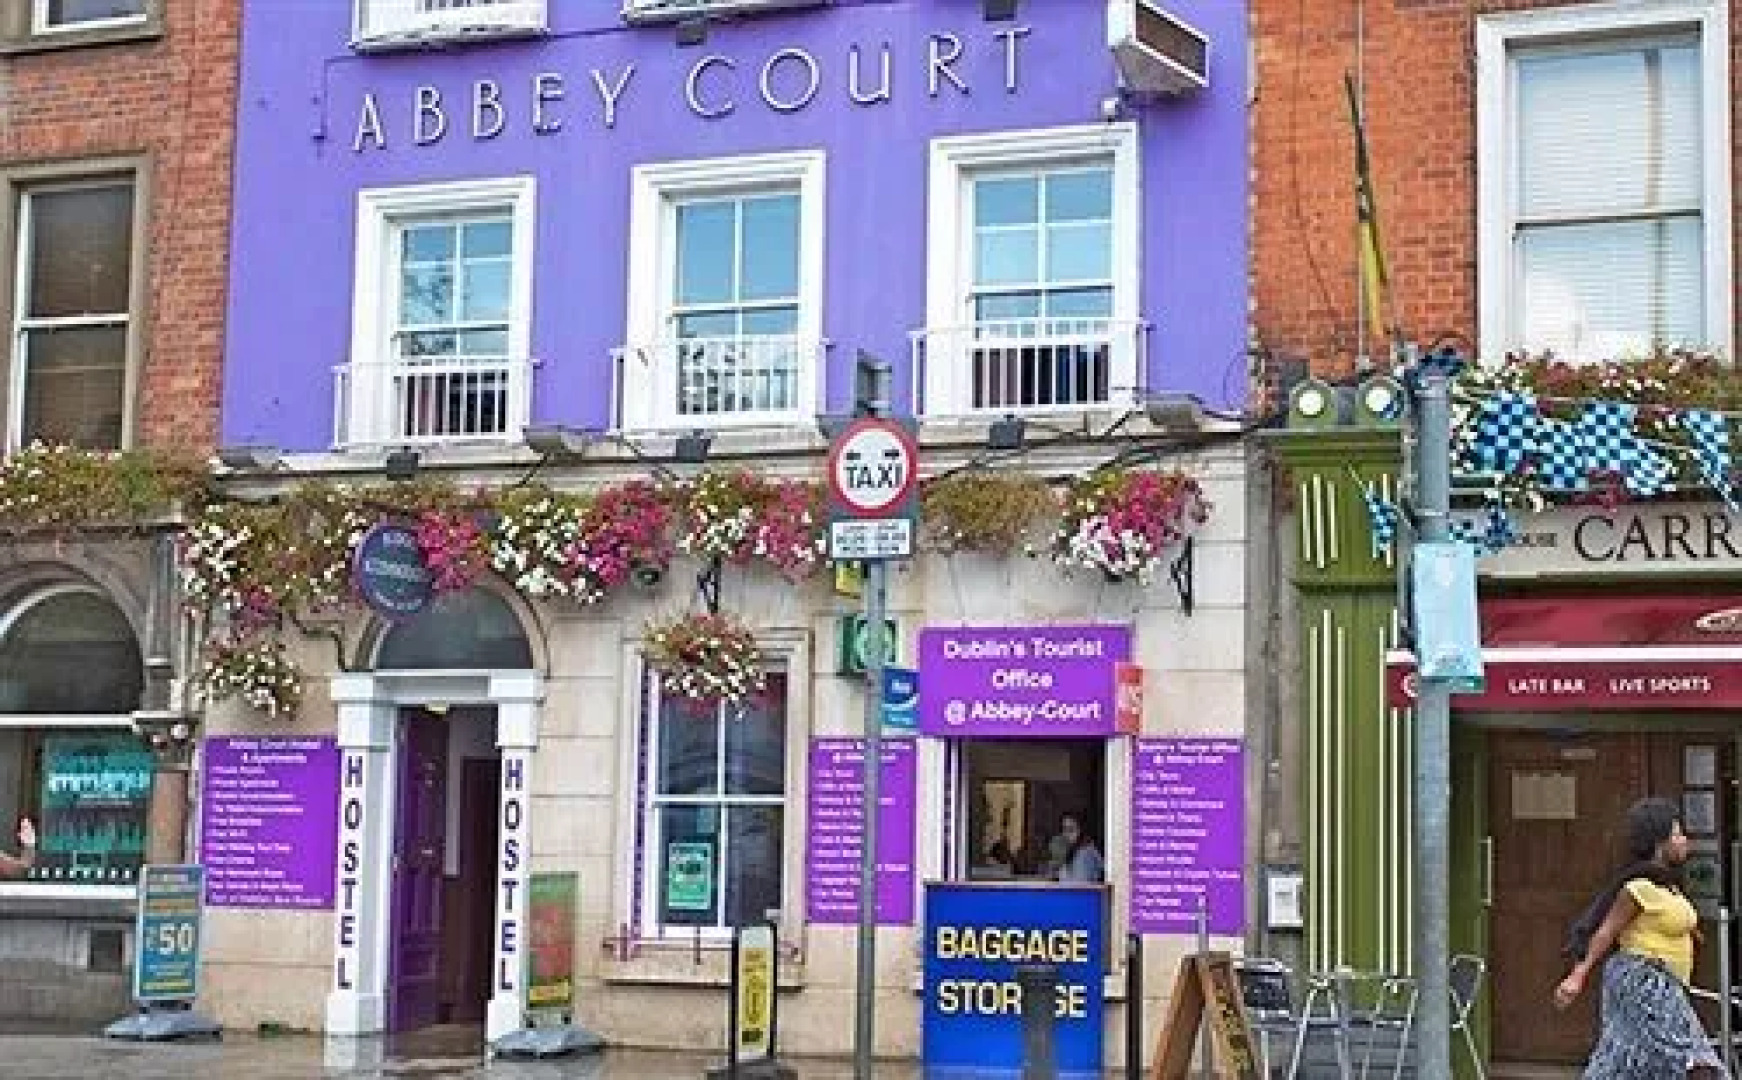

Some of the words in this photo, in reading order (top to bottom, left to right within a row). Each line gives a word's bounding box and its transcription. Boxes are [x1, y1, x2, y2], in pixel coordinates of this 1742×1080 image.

[352, 65, 636, 153] ABBEY
[685, 27, 1031, 119] COURT
[843, 463, 904, 489] TAXI
[1574, 513, 1742, 562] CARR
[943, 639, 1025, 659] Dublin's
[1030, 637, 1103, 658] Tourist
[991, 668, 1053, 690] Office
[1508, 677, 1548, 694] LATE
[1553, 677, 1586, 694] BAR
[1609, 676, 1645, 693] LIVE
[1650, 675, 1712, 693] SPORTS
[944, 700, 965, 725] @
[337, 755, 363, 990] HOSTEL
[501, 758, 523, 991] HOSTEL
[936, 926, 1088, 963] BAGGAGE
[937, 981, 1088, 1018] STORGE
